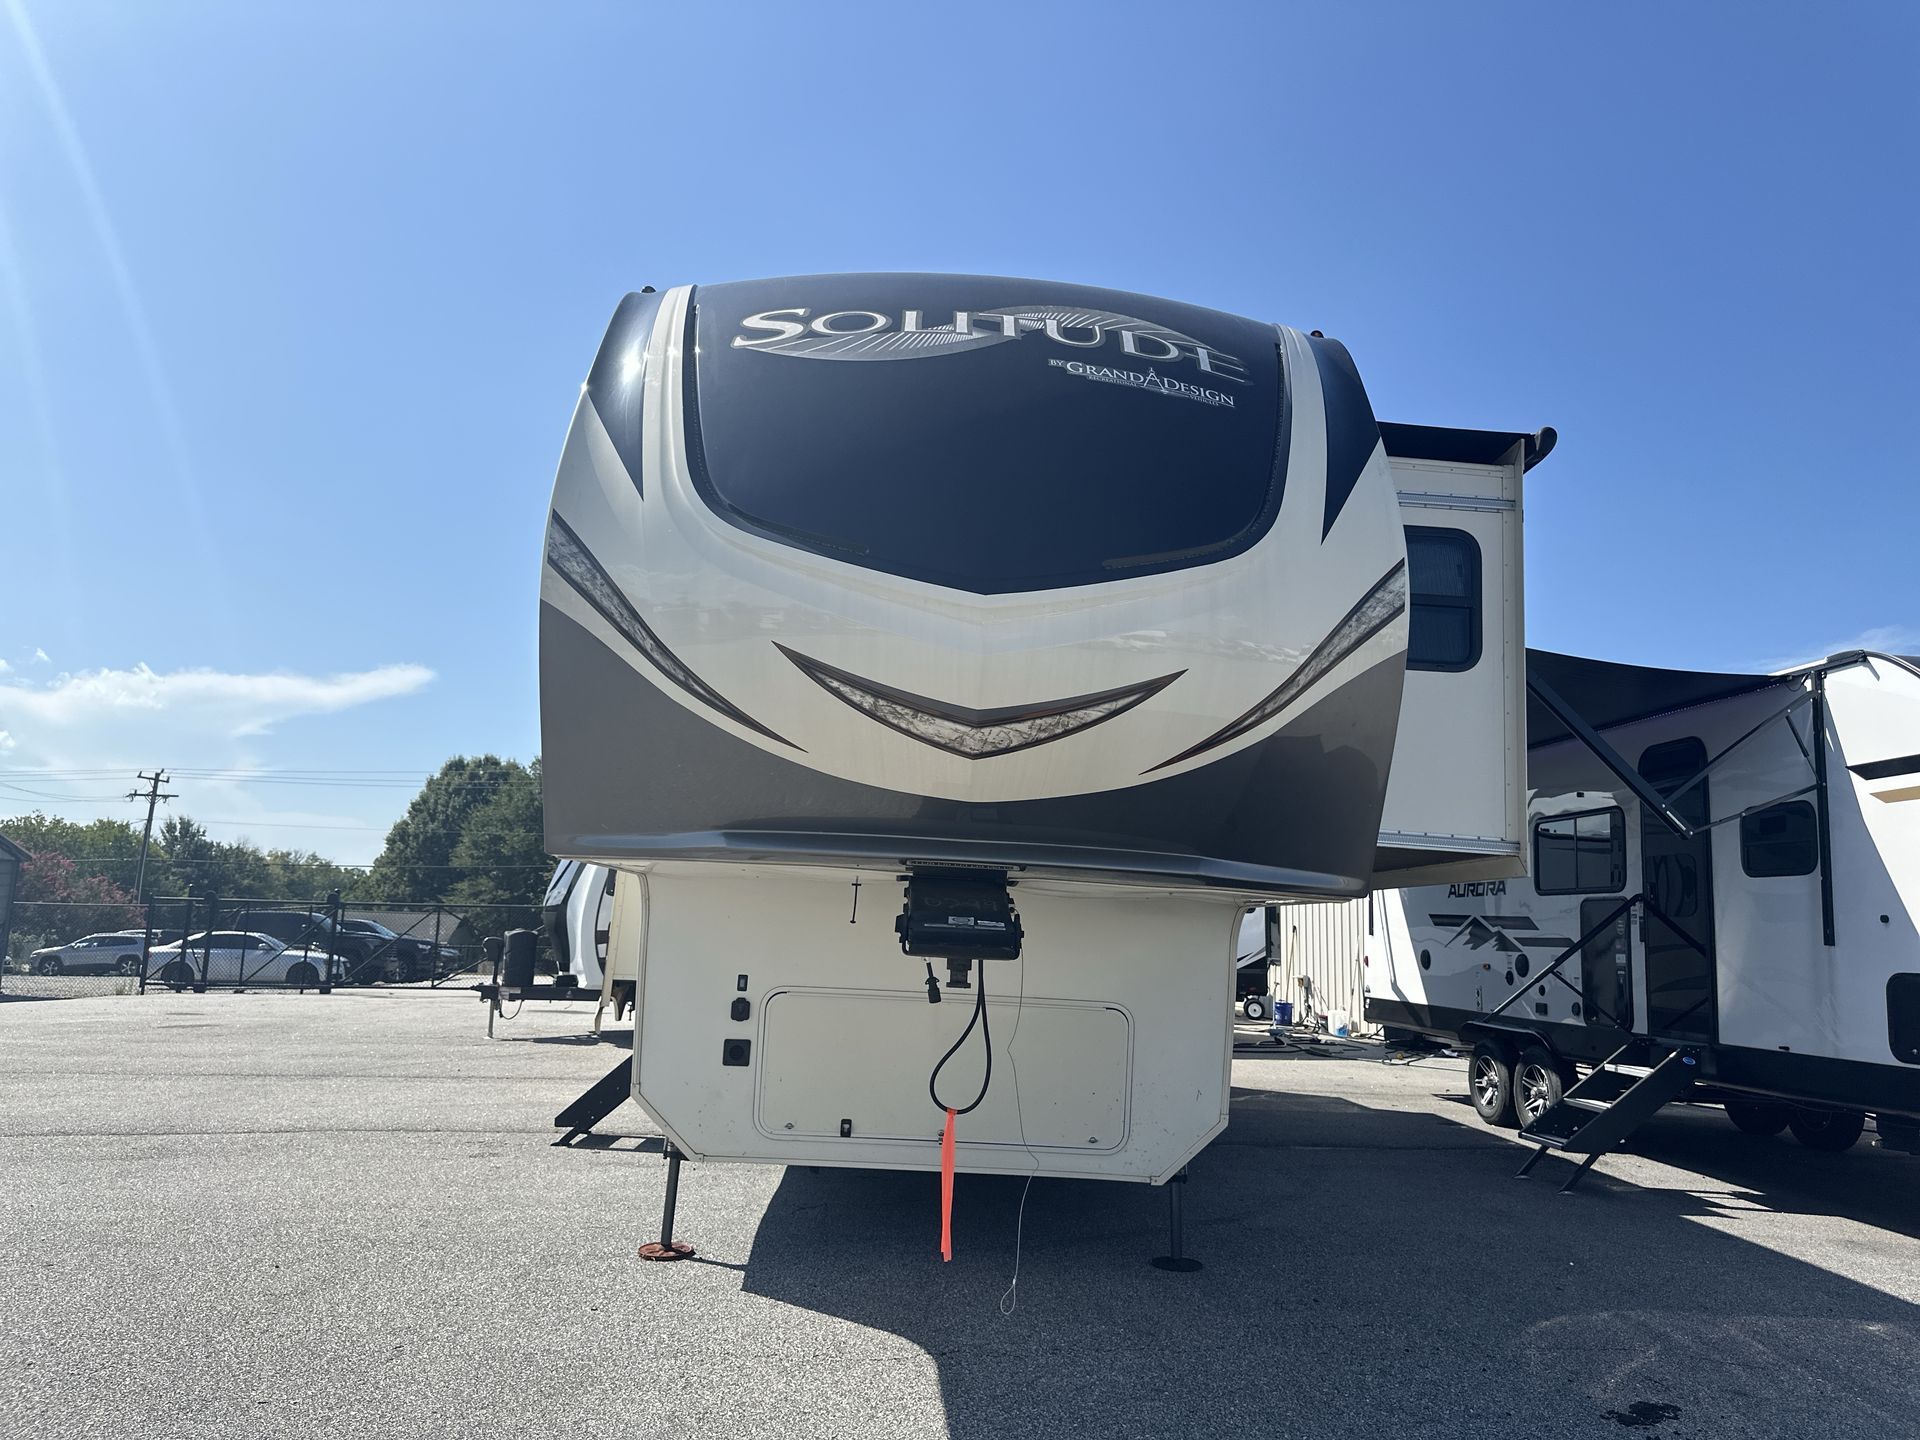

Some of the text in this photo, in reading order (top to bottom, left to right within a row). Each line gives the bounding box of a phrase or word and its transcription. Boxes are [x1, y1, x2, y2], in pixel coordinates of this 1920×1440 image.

[731, 308, 1248, 383] SOLITUDE
[1050, 359, 1064, 367] BY
[1448, 880, 1506, 898] AURORA
